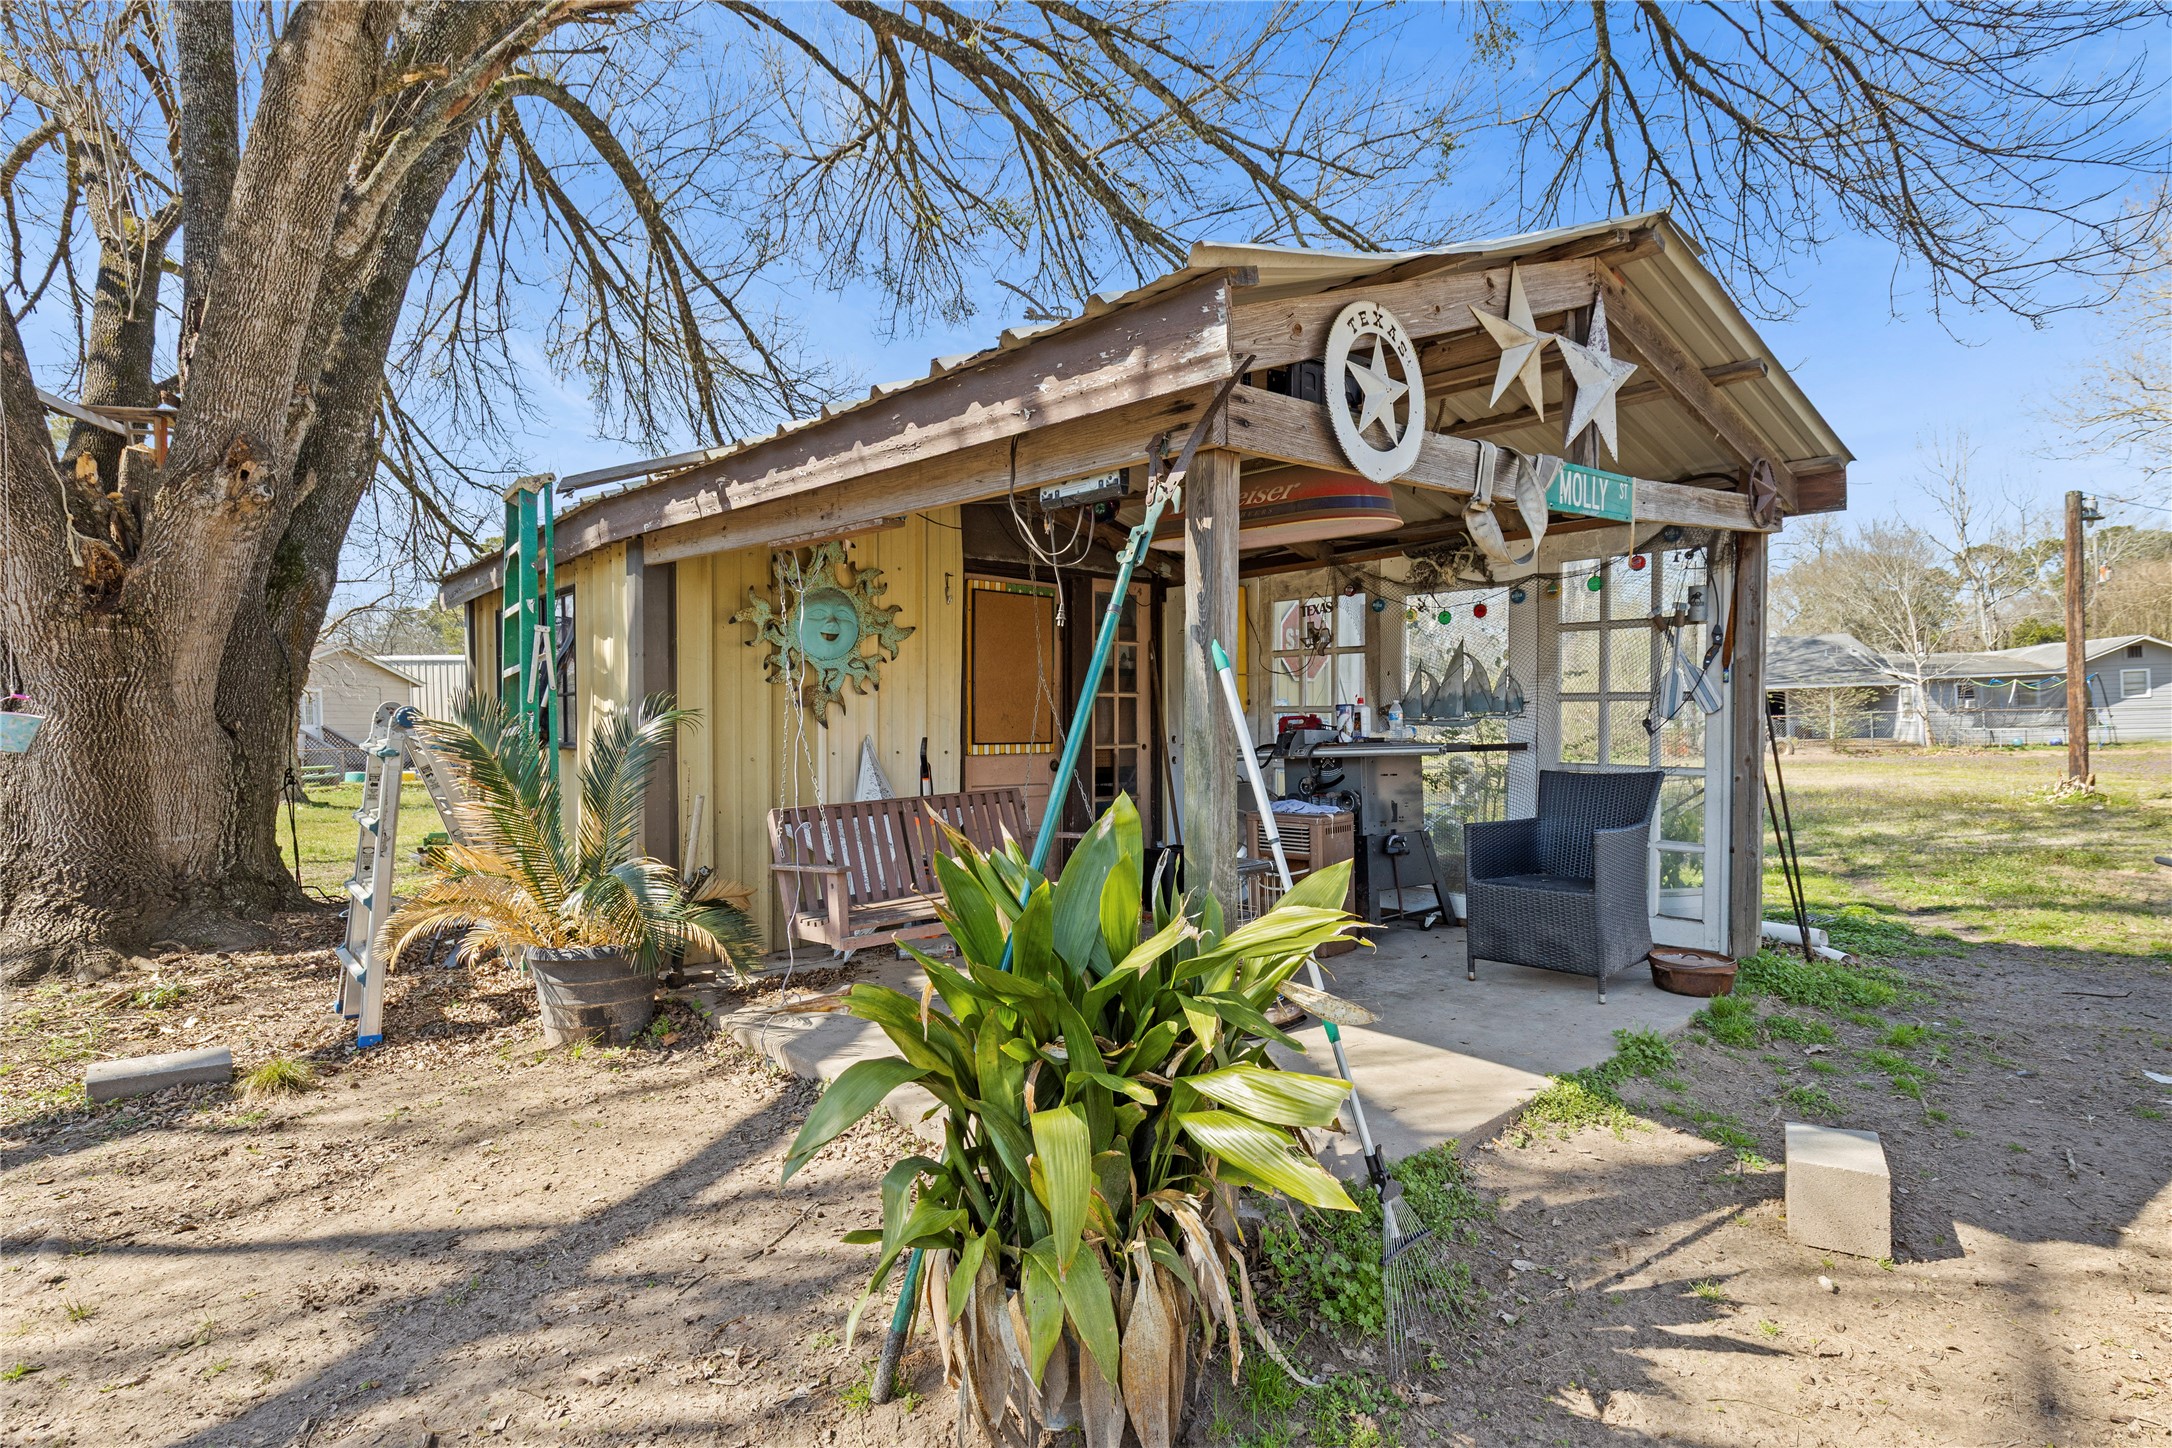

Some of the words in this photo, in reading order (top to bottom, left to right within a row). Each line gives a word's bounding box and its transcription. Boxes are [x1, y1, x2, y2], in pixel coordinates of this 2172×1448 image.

[1347, 310, 1408, 357] TEXAS
[1560, 469, 1609, 512] MOLLY
[1619, 482, 1629, 500] ST
[1300, 601, 1334, 617] TEXAS
